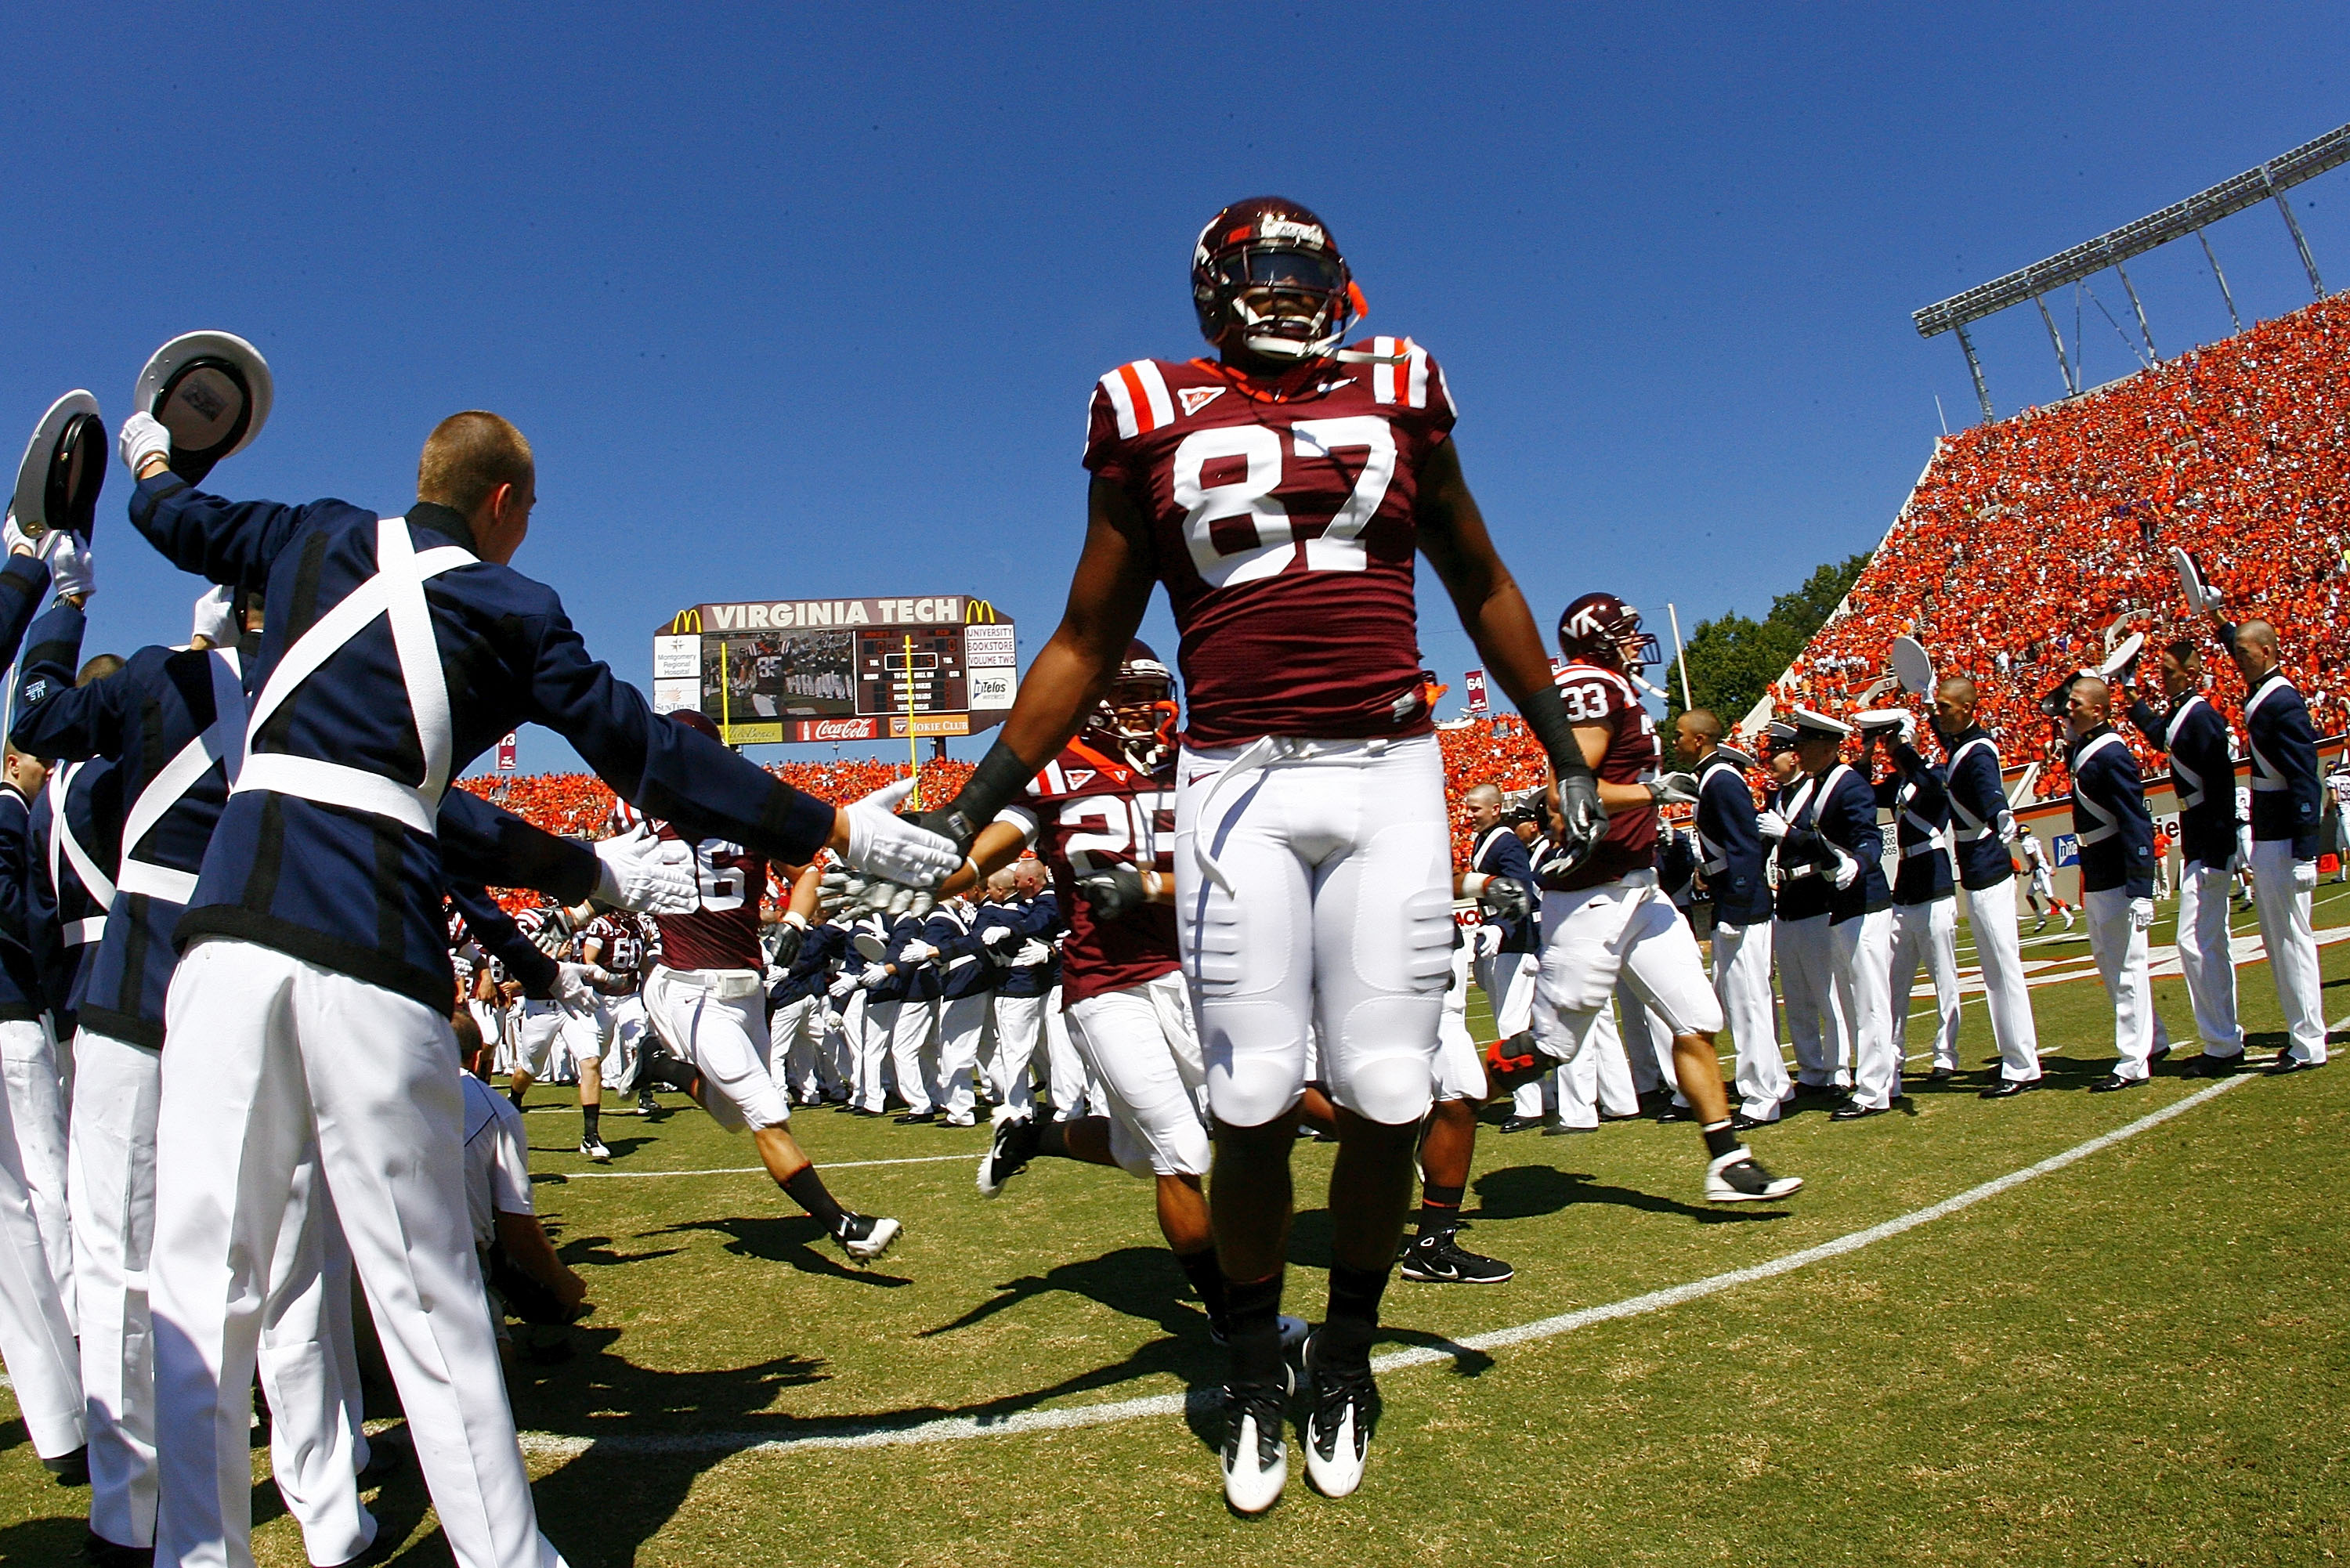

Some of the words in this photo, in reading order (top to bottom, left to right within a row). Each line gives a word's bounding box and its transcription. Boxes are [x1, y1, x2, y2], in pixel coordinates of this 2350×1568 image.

[1173, 415, 1397, 588] 87
[712, 602, 870, 629] VIRGINIA
[878, 598, 958, 623] TECH
[968, 628, 1013, 638] UNIVERSITY
[968, 641, 1013, 651] BOOKSTORE
[998, 656, 1015, 664] TWO
[1466, 677, 1484, 691] 64
[1560, 682, 1610, 723] 33
[815, 718, 873, 740] Coca-Cola
[942, 721, 969, 731] CLUB
[612, 938, 644, 969] 60
